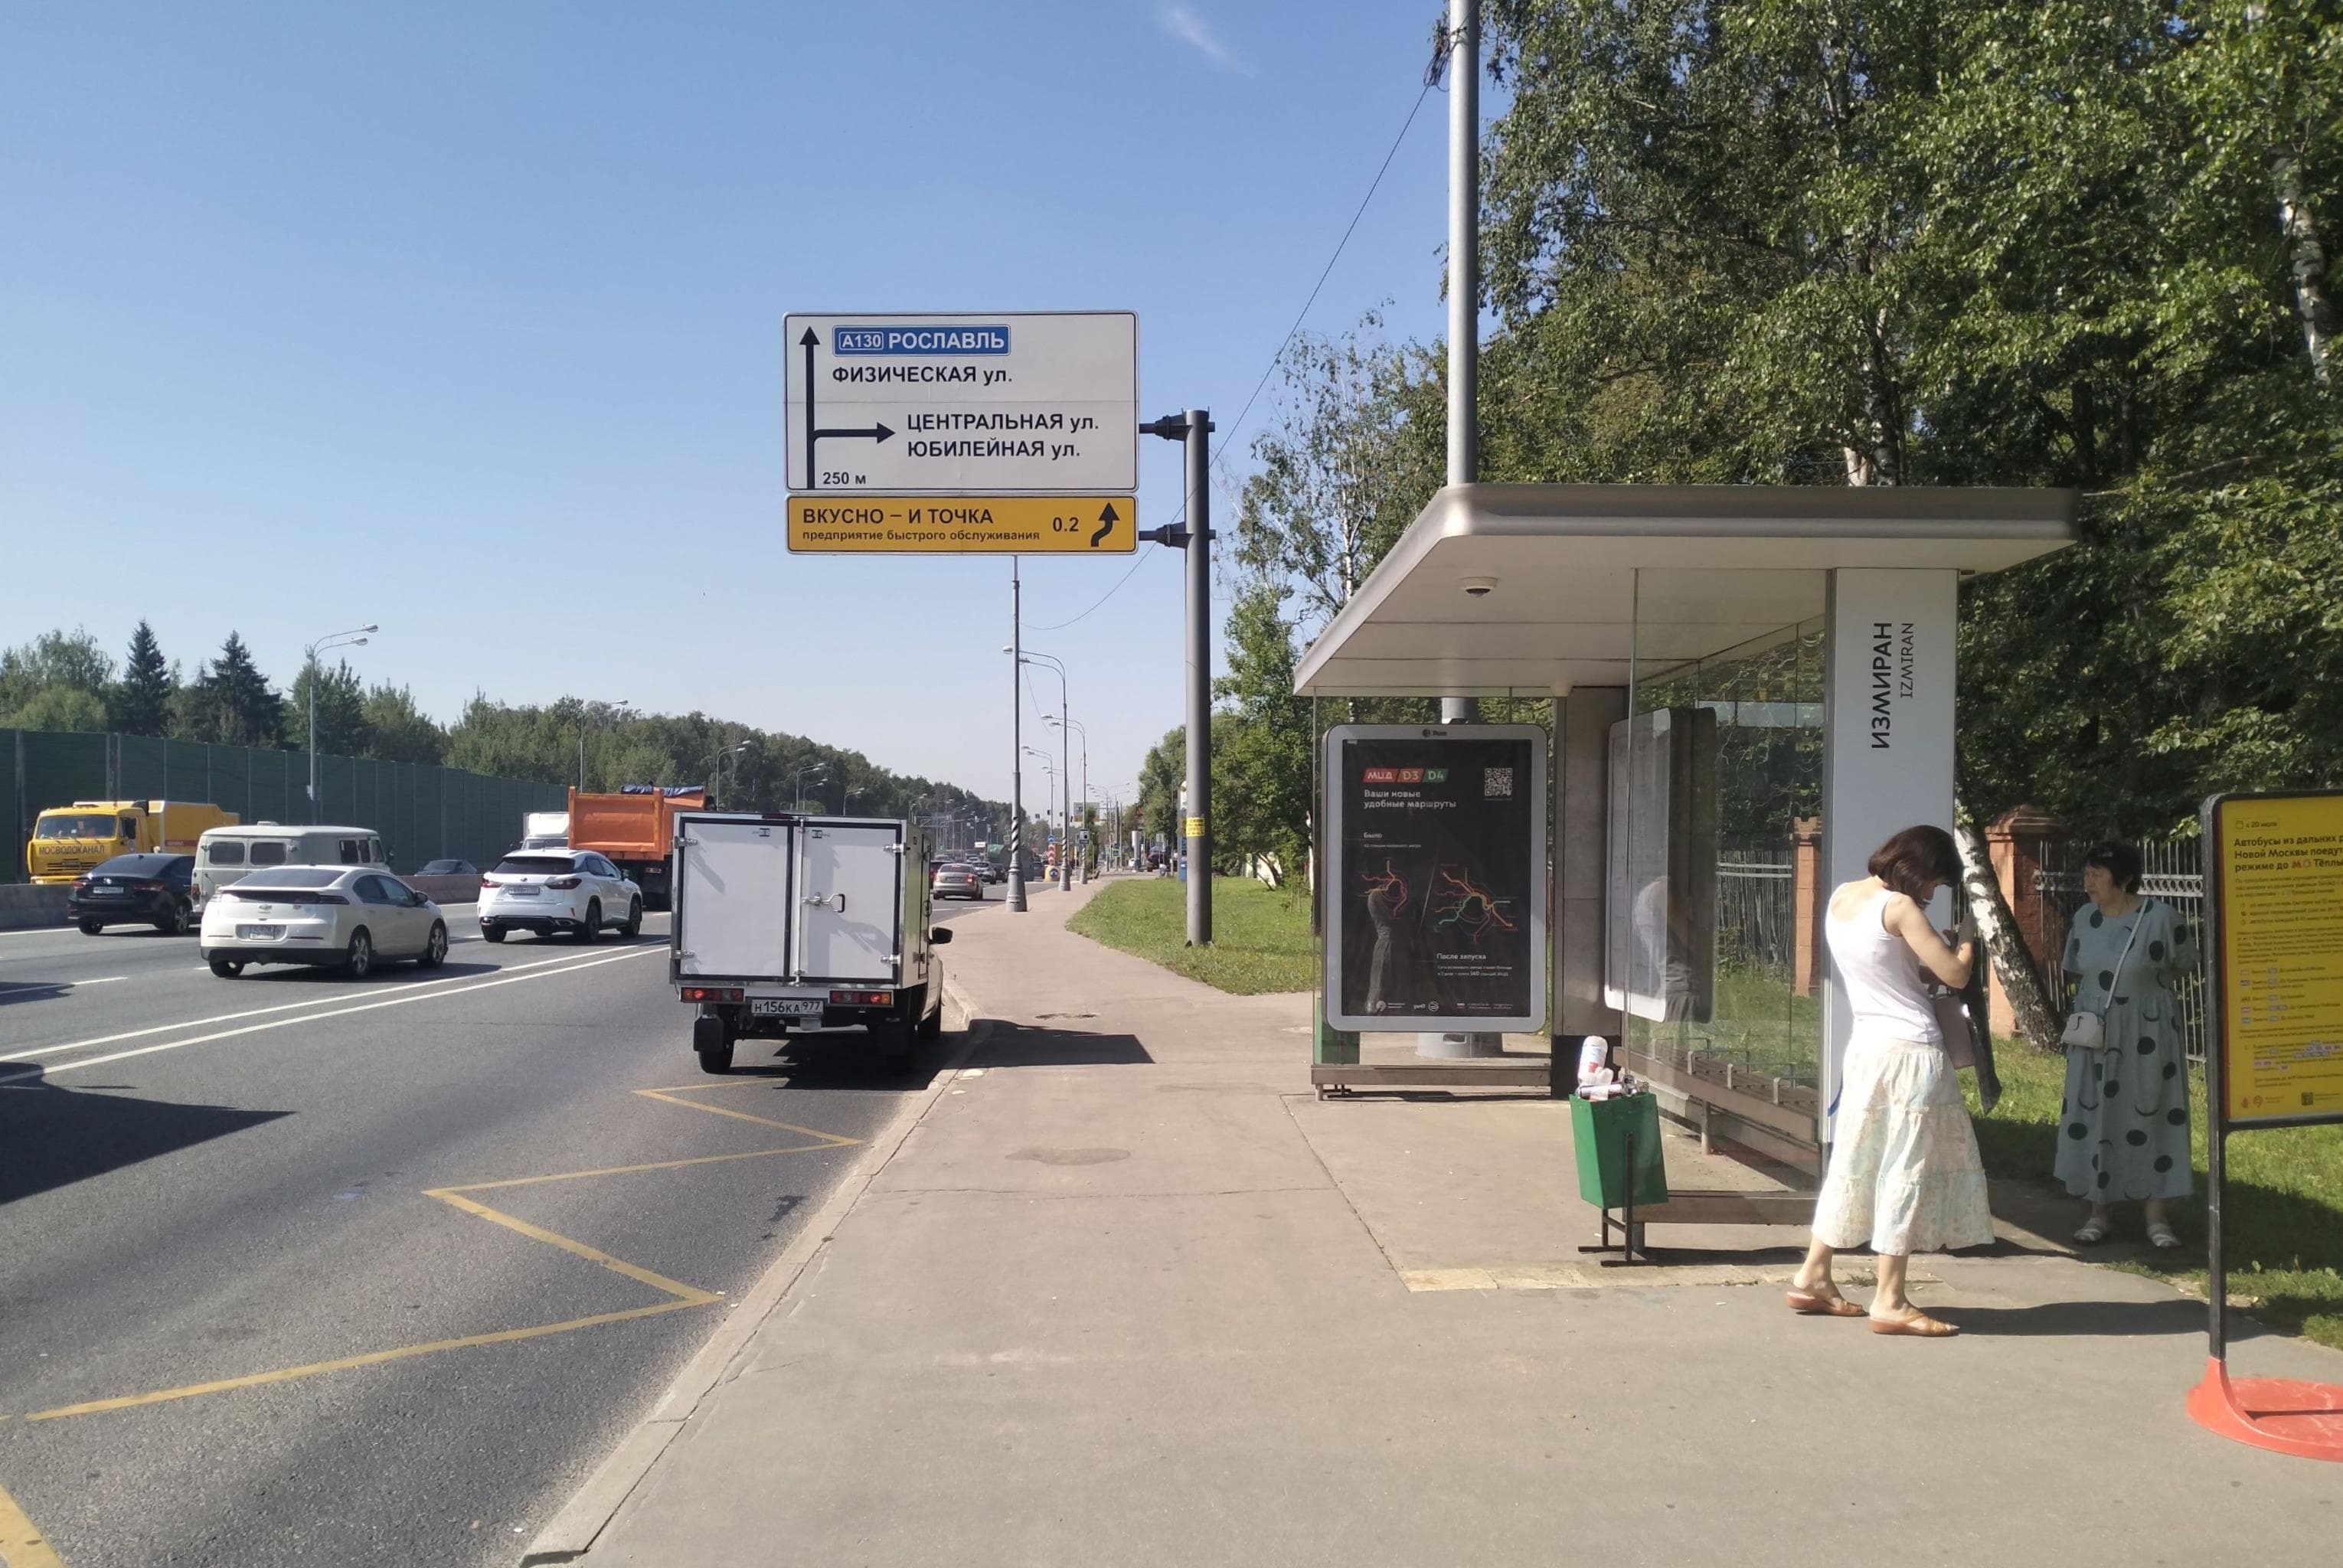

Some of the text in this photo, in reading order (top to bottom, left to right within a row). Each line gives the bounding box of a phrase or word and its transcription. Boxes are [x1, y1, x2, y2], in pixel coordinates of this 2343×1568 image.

[888, 332, 1005, 349] РОСЛАВЛЬ
[832, 366, 1012, 386] ФИЗИЧЕСКАЯ ул.
[907, 413, 1099, 434] ЦЕНТРАЛЬНАЯ ул.
[907, 437, 1080, 461] ЮБИЛЕЙНАЯ ул.
[822, 472, 866, 485] 250 м
[803, 508, 884, 524] ВКУСНО
[909, 508, 921, 524] И
[927, 508, 994, 524] ТОЧКА
[1053, 517, 1080, 532] 0.2
[802, 529, 1041, 543] предприятие быстрого обслуживания
[1900, 622, 1914, 699] IZMIRAN
[1871, 622, 1893, 749] ИЗМИРАН
[1403, 770, 1420, 780] D3
[1427, 770, 1445, 781] D4
[1364, 789, 1390, 798] Ваши
[1364, 799, 1456, 809] удобные маршруты
[2234, 837, 2281, 847] Автобусы
[2296, 835, 2336, 844] дальних
[39, 844, 105, 855] МОСВОДОКАНАЛ
[2235, 848, 2266, 859] Новой
[2268, 849, 2308, 858] Москвы
[2236, 863, 2274, 873] режиме
[2276, 862, 2289, 871] до
